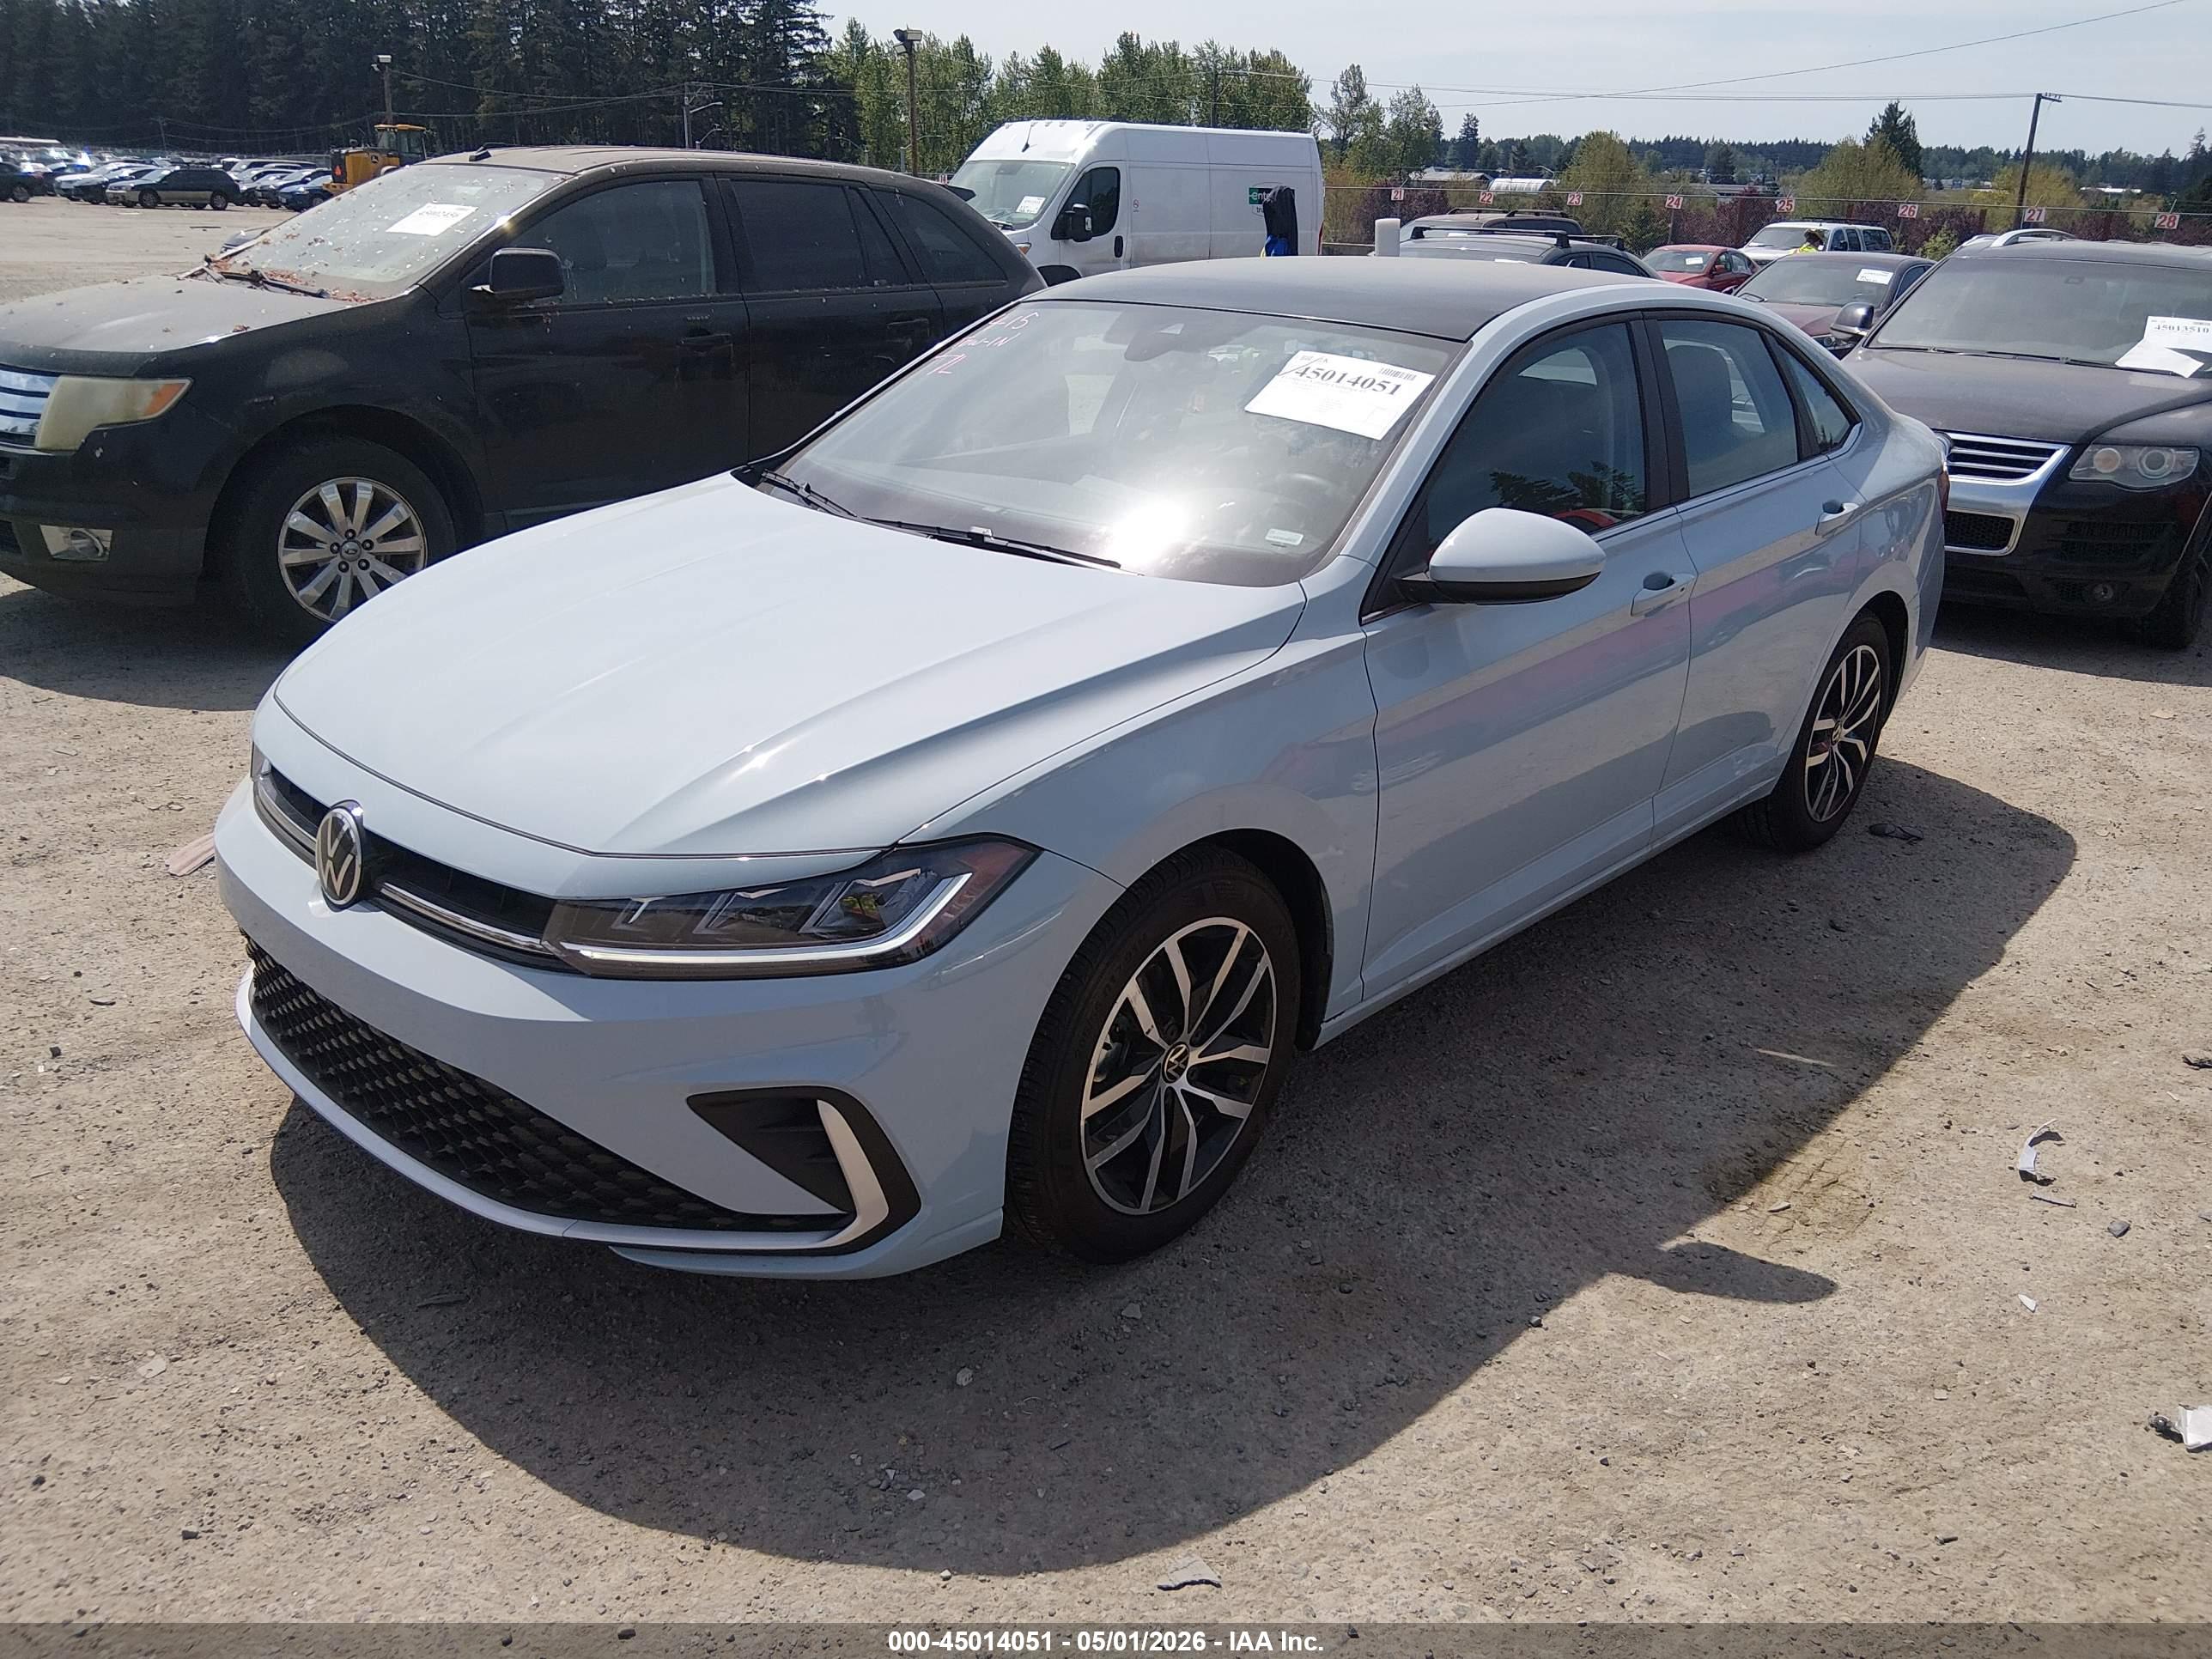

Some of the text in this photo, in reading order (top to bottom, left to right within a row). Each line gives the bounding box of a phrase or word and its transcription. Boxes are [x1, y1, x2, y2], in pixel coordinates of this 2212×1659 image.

[1394, 190, 1402, 200] 21
[1480, 191, 1492, 203] 22
[1568, 194, 1581, 205] 23
[1666, 195, 1681, 209] 24
[1778, 198, 1793, 211] 25
[1899, 204, 1917, 217] 26
[2027, 209, 2044, 221] 27
[2156, 214, 2177, 228] 28
[1294, 366, 1403, 396] 45014051
